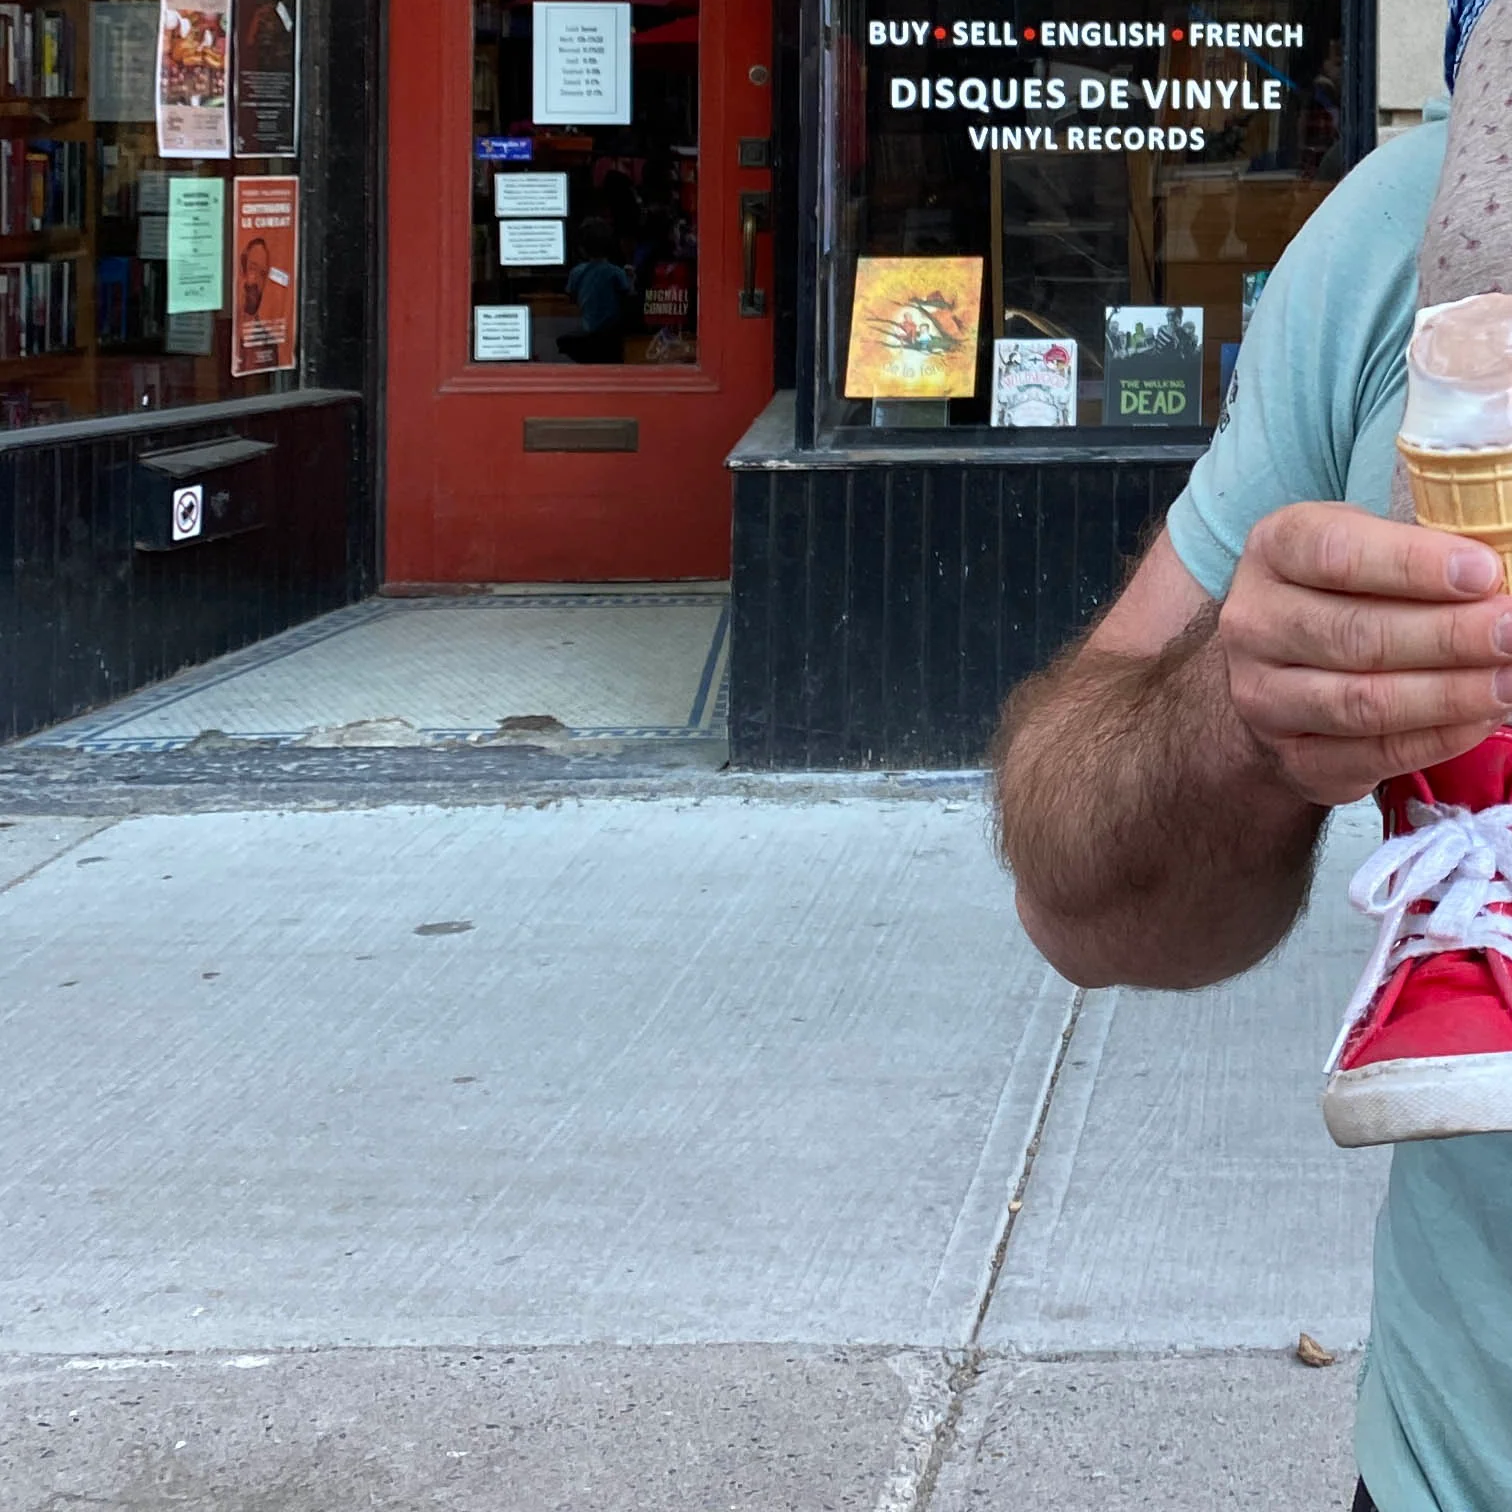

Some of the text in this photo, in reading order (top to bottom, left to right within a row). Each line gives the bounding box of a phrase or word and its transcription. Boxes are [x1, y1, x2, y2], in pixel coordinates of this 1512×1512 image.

[870, 22, 1302, 47] BUY SELL ENGLISH FRENCH
[892, 78, 1282, 112] DISQUES DE VINYLE
[969, 127, 1204, 150] VINYL RECORDS
[1120, 379, 1186, 389] THE WALKING
[1120, 390, 1187, 416] DEAD
